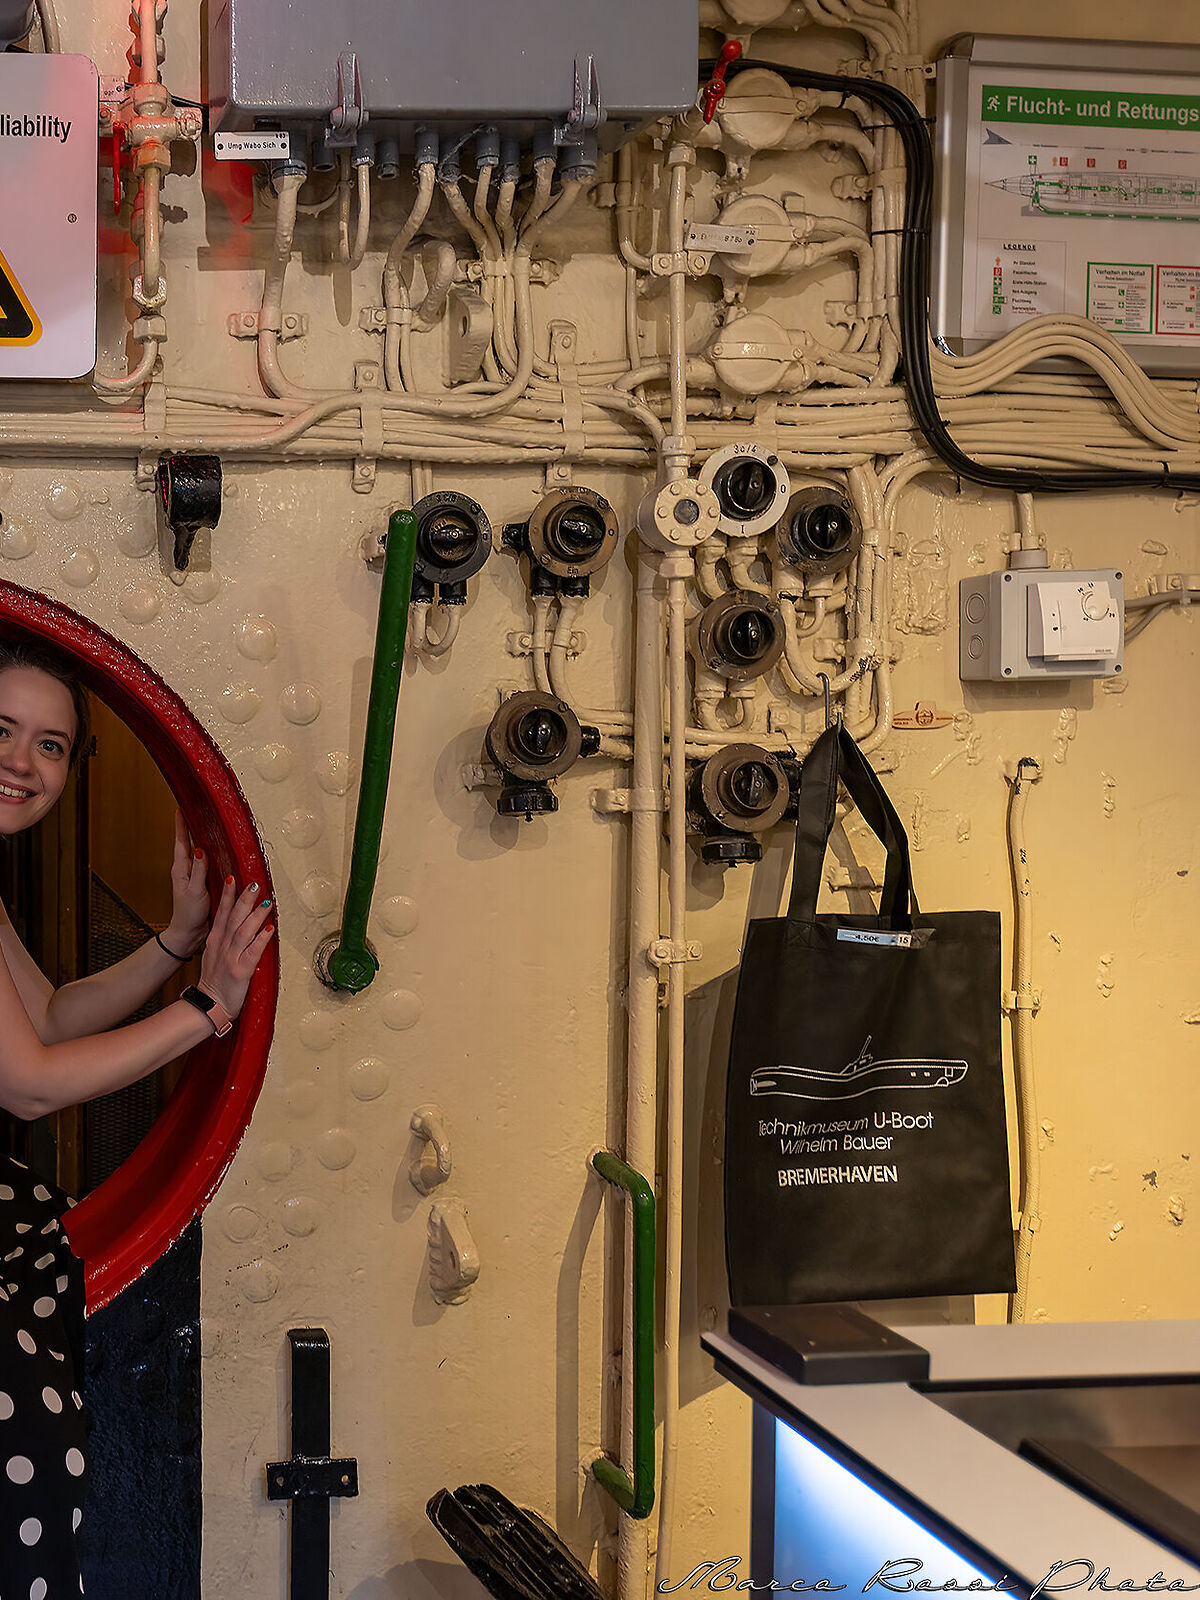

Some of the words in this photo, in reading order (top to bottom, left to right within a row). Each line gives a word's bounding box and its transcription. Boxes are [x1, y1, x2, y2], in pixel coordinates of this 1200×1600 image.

[1007, 95, 1071, 116] Flucht-
[1077, 101, 1111, 118] und
[1117, 101, 1200, 126] Rettungs
[0, 114, 72, 143] liability
[758, 1116, 869, 1137] Technikmuseum
[873, 1111, 935, 1130] U-Boot
[780, 1136, 838, 1155] Wilhelm
[843, 1134, 894, 1151] Bauer
[777, 1165, 899, 1188] BREMERHAVEN
